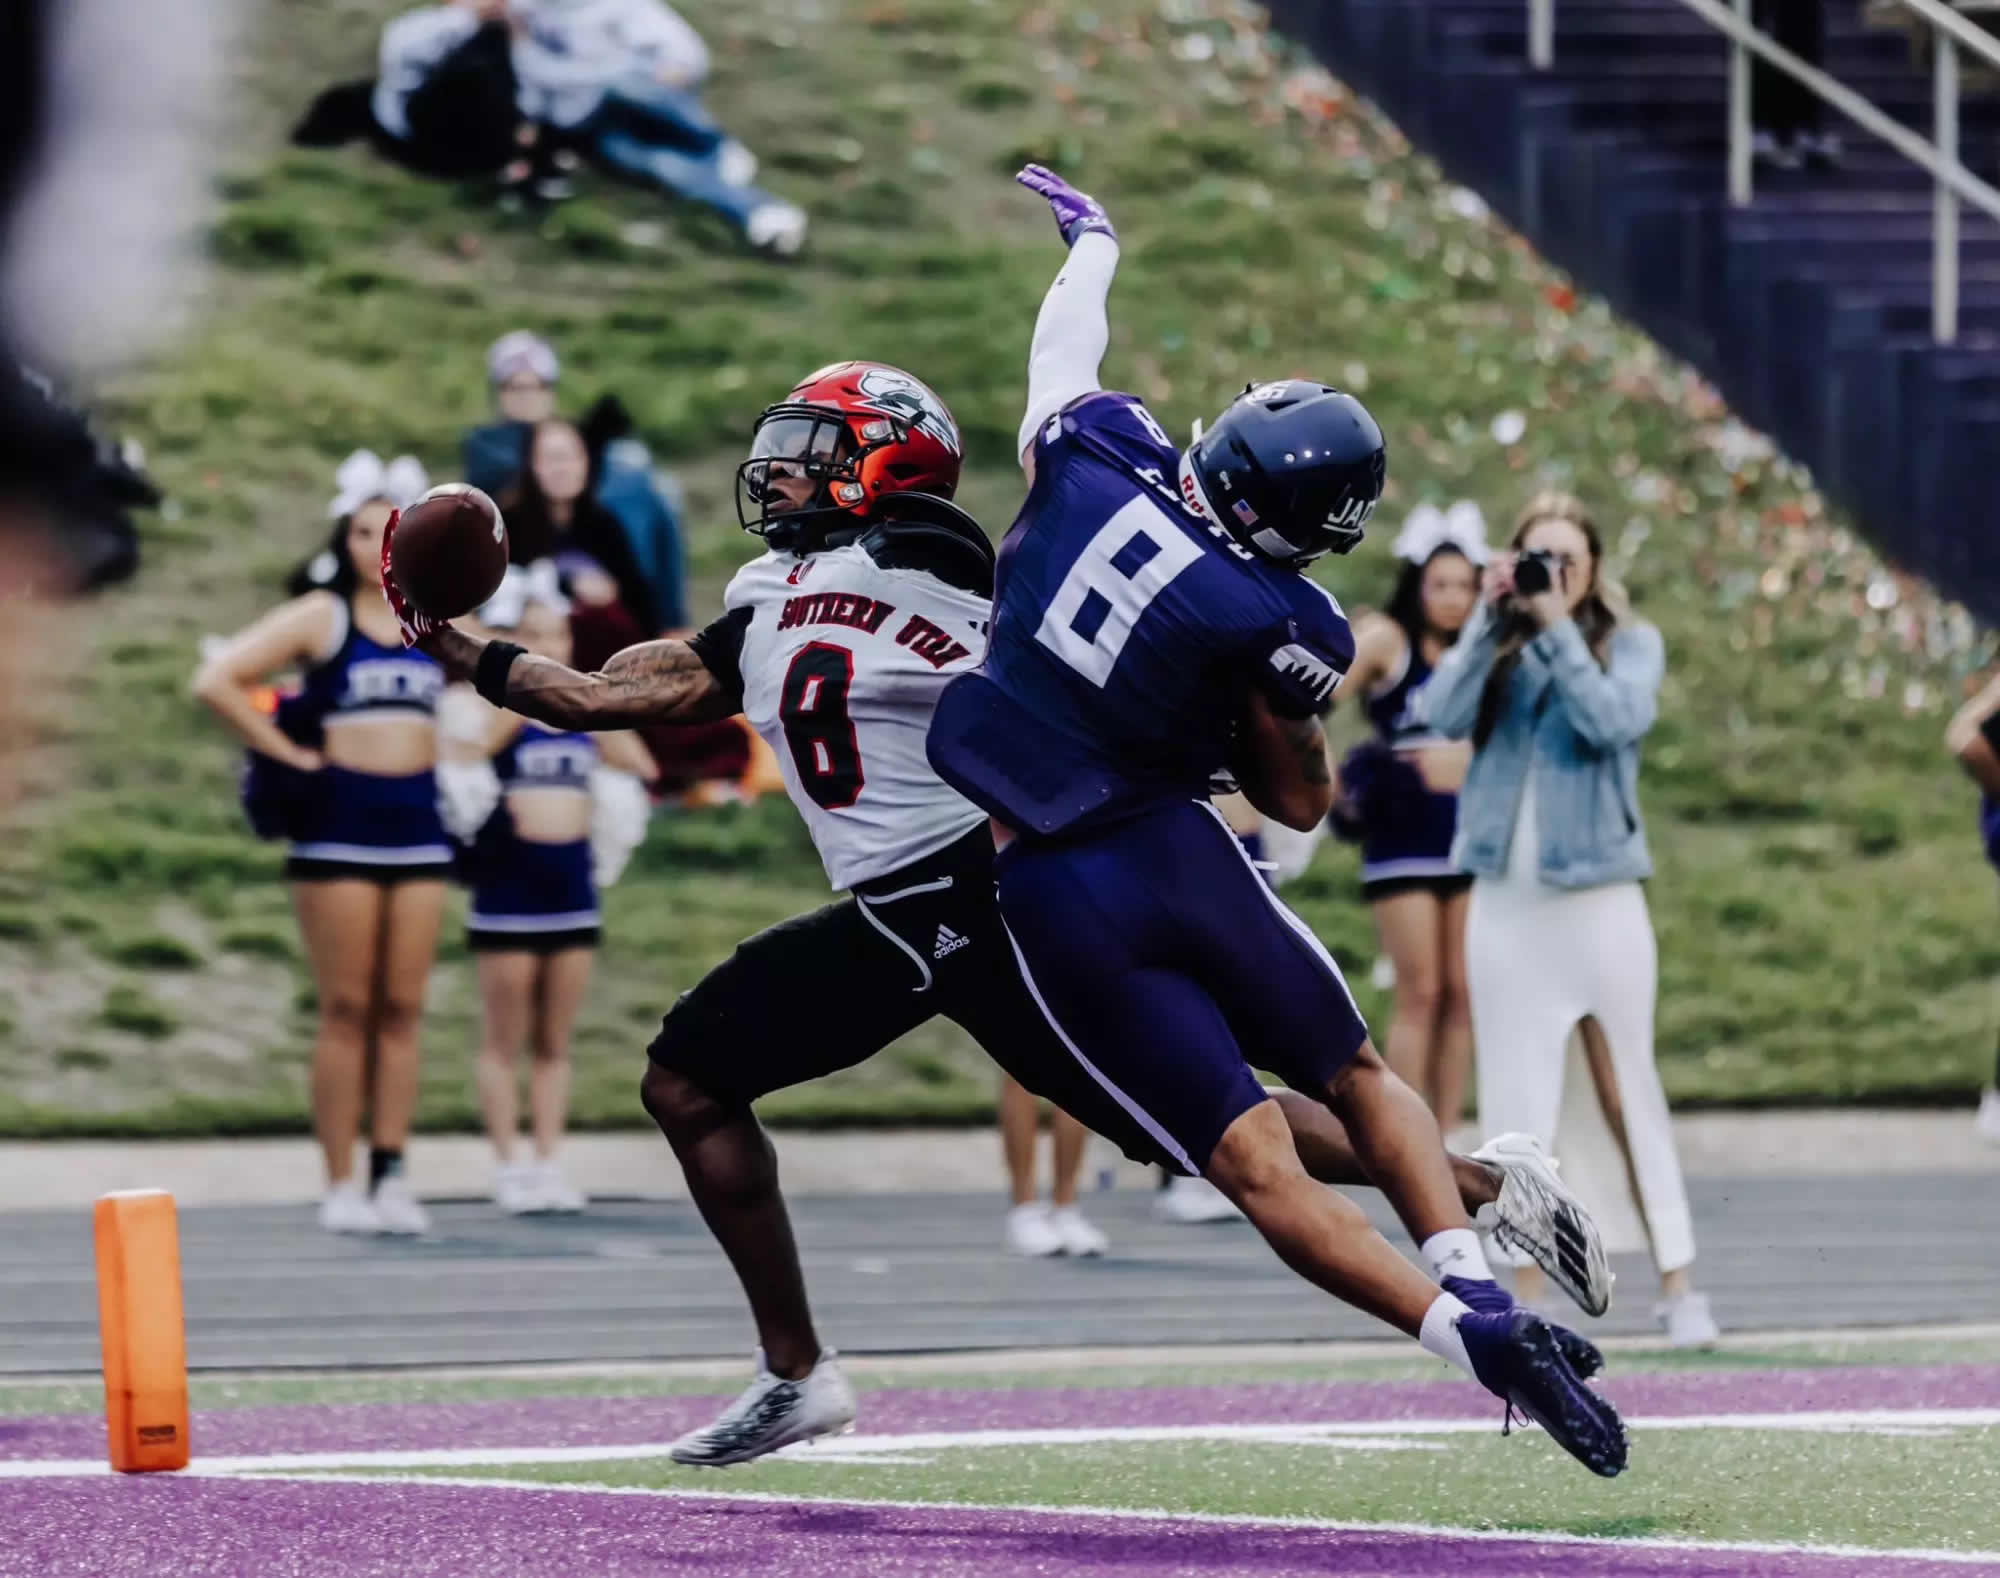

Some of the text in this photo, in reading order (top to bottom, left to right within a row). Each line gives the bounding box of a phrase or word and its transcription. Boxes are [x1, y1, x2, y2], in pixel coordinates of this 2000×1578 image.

[1034, 492, 1206, 688] 8
[778, 640, 865, 811] 8
[934, 935, 970, 959] adidas
